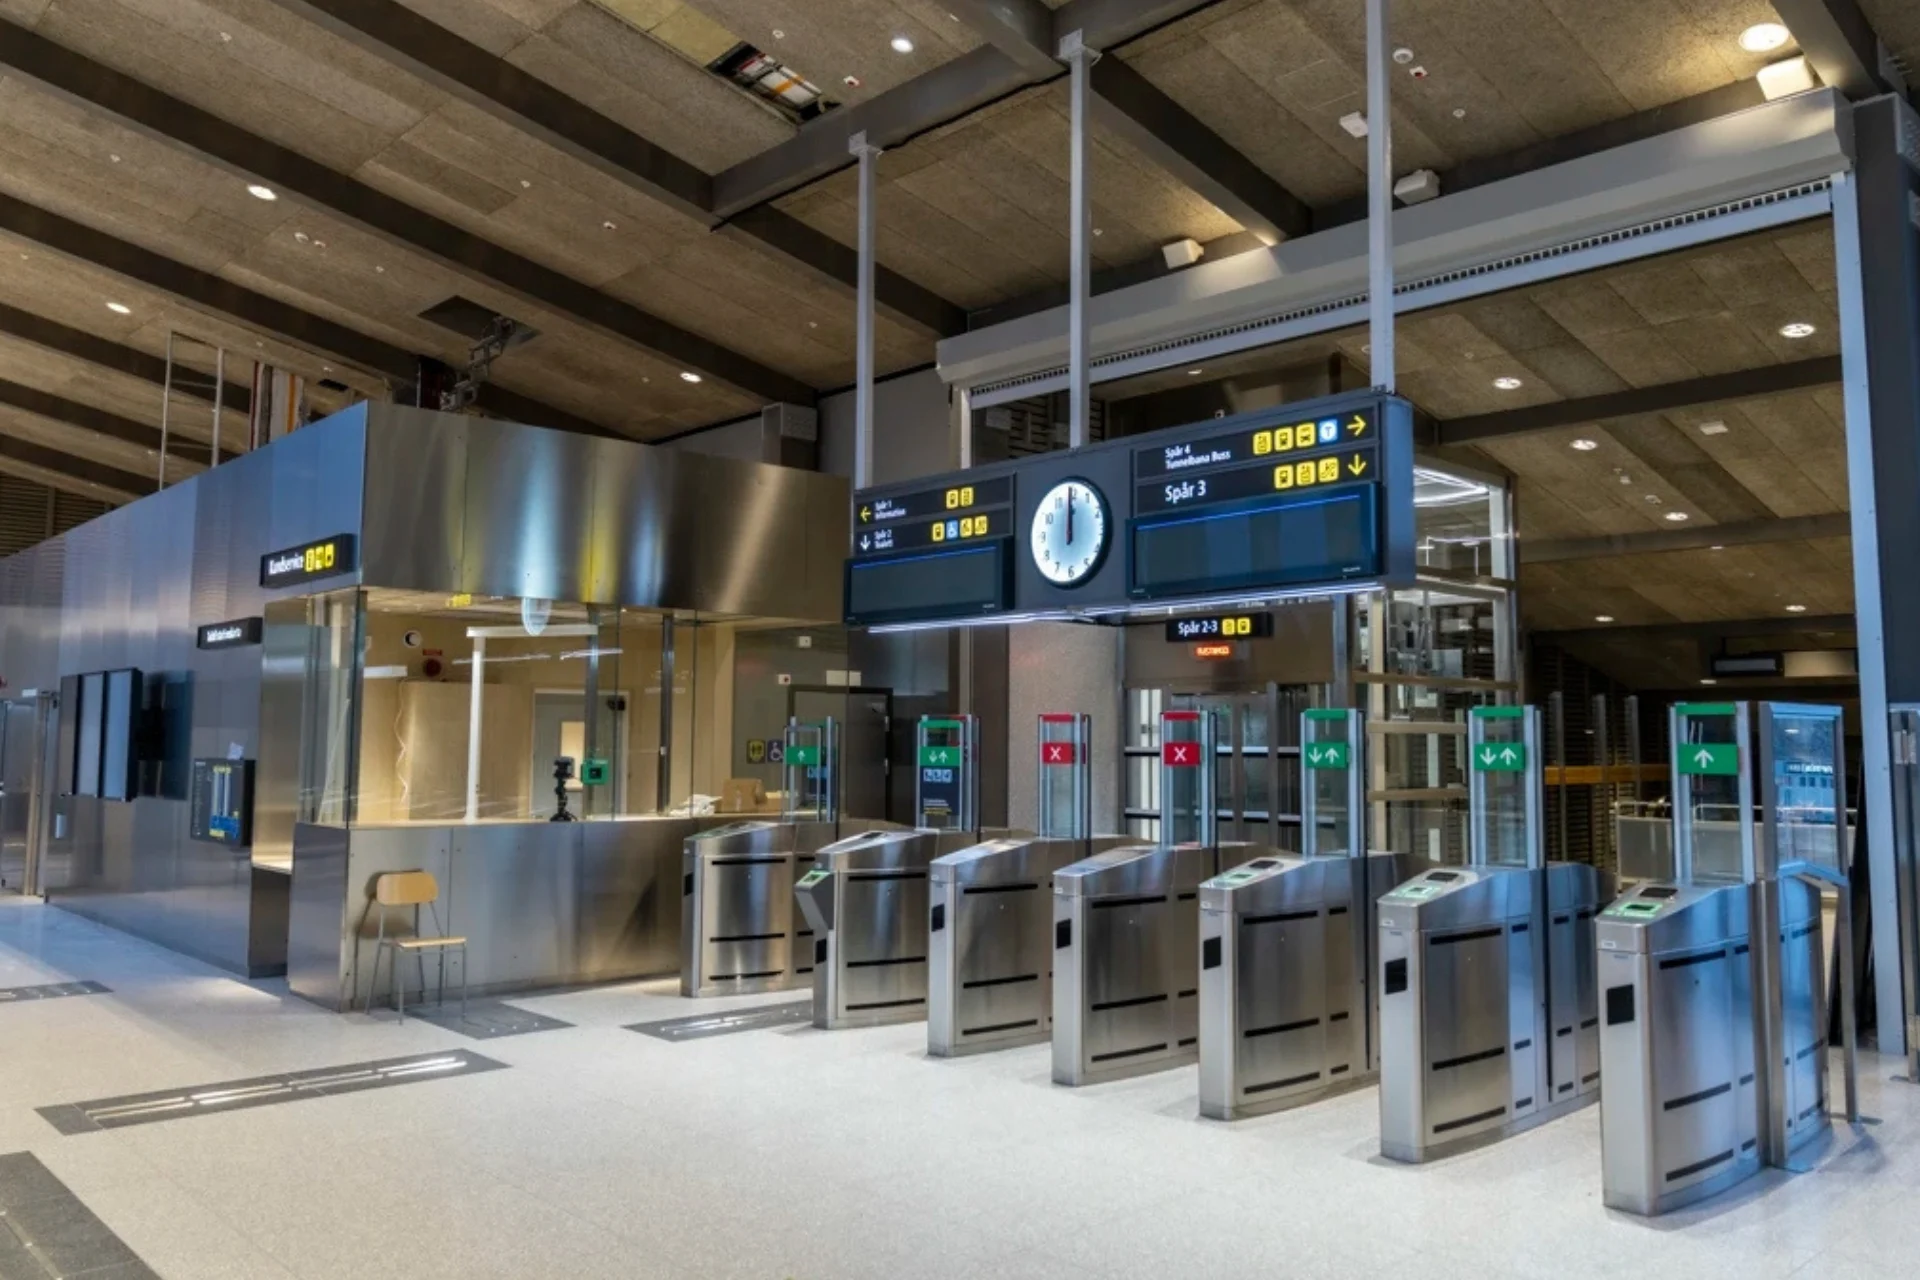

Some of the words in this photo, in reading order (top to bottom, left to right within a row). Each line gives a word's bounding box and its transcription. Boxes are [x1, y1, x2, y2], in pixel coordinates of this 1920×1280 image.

[1165, 445, 1184, 459] Spår
[1184, 444, 1191, 454] 4
[1165, 481, 1195, 504] Spår
[1197, 479, 1206, 497] 3
[1178, 621, 1200, 637] Spår
[1202, 620, 1218, 633] 2-3
